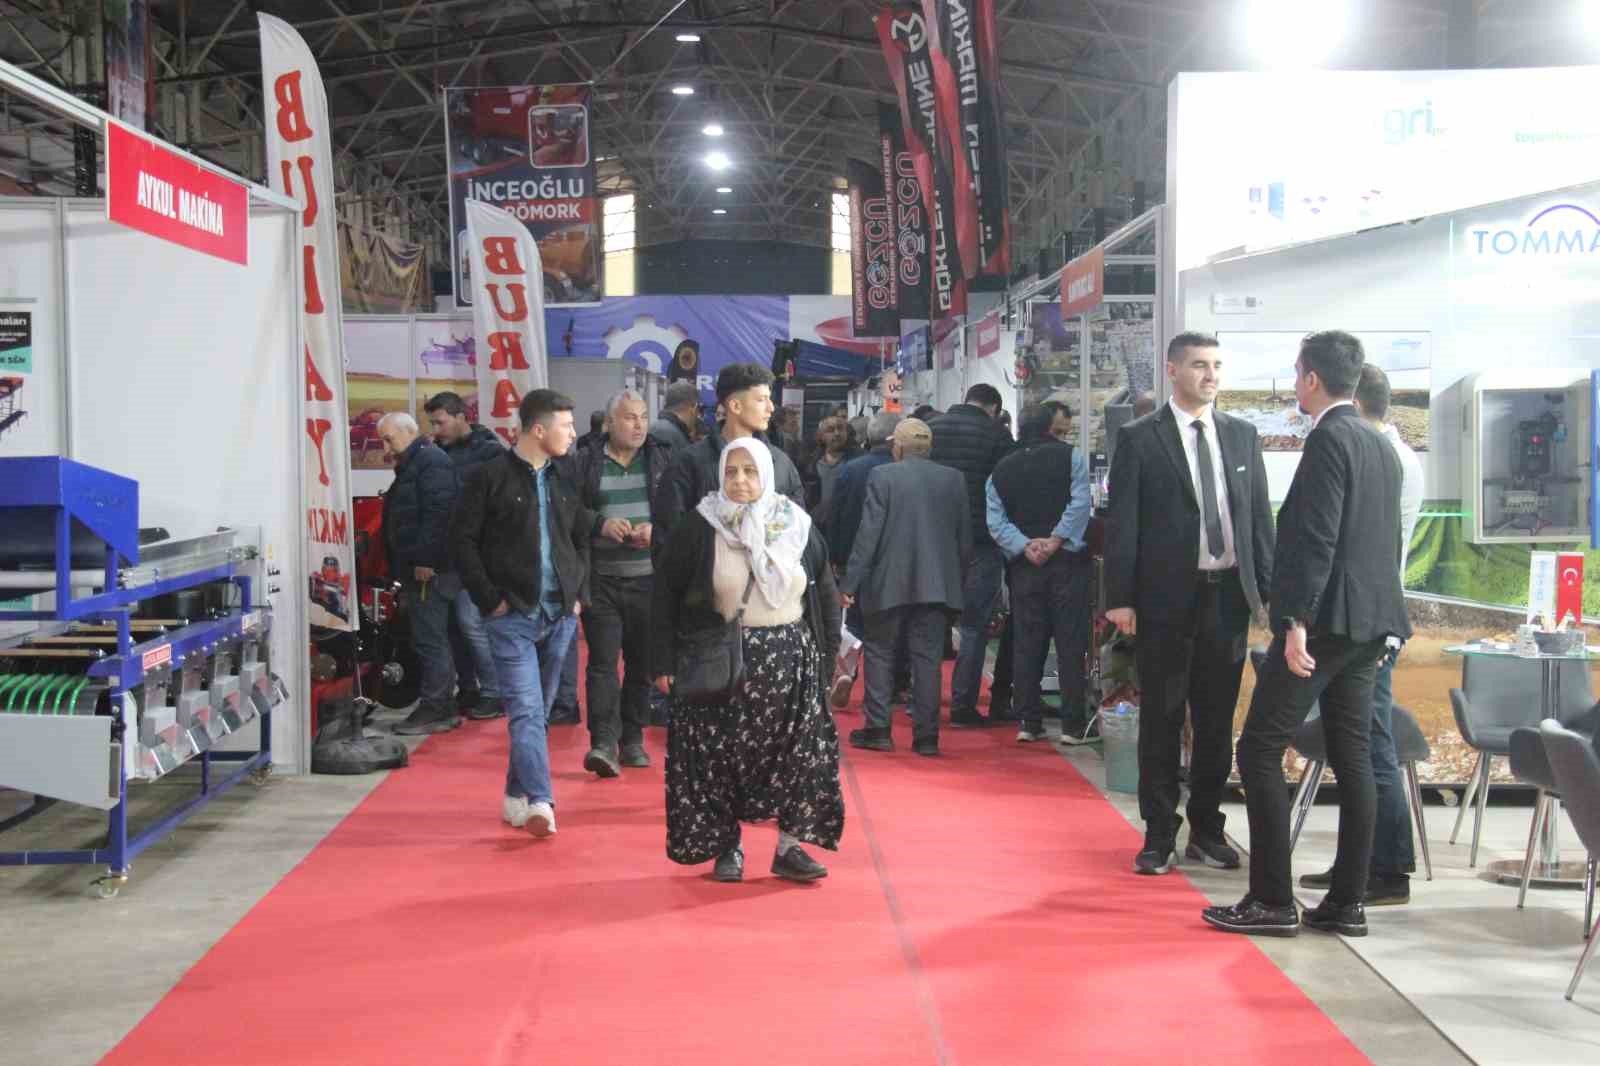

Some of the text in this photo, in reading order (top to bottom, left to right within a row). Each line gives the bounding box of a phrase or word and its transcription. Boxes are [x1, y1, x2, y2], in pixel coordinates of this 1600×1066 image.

[137, 169, 224, 237] AYKUL MAKİNA
[467, 176, 585, 201] İNCEOĞLU
